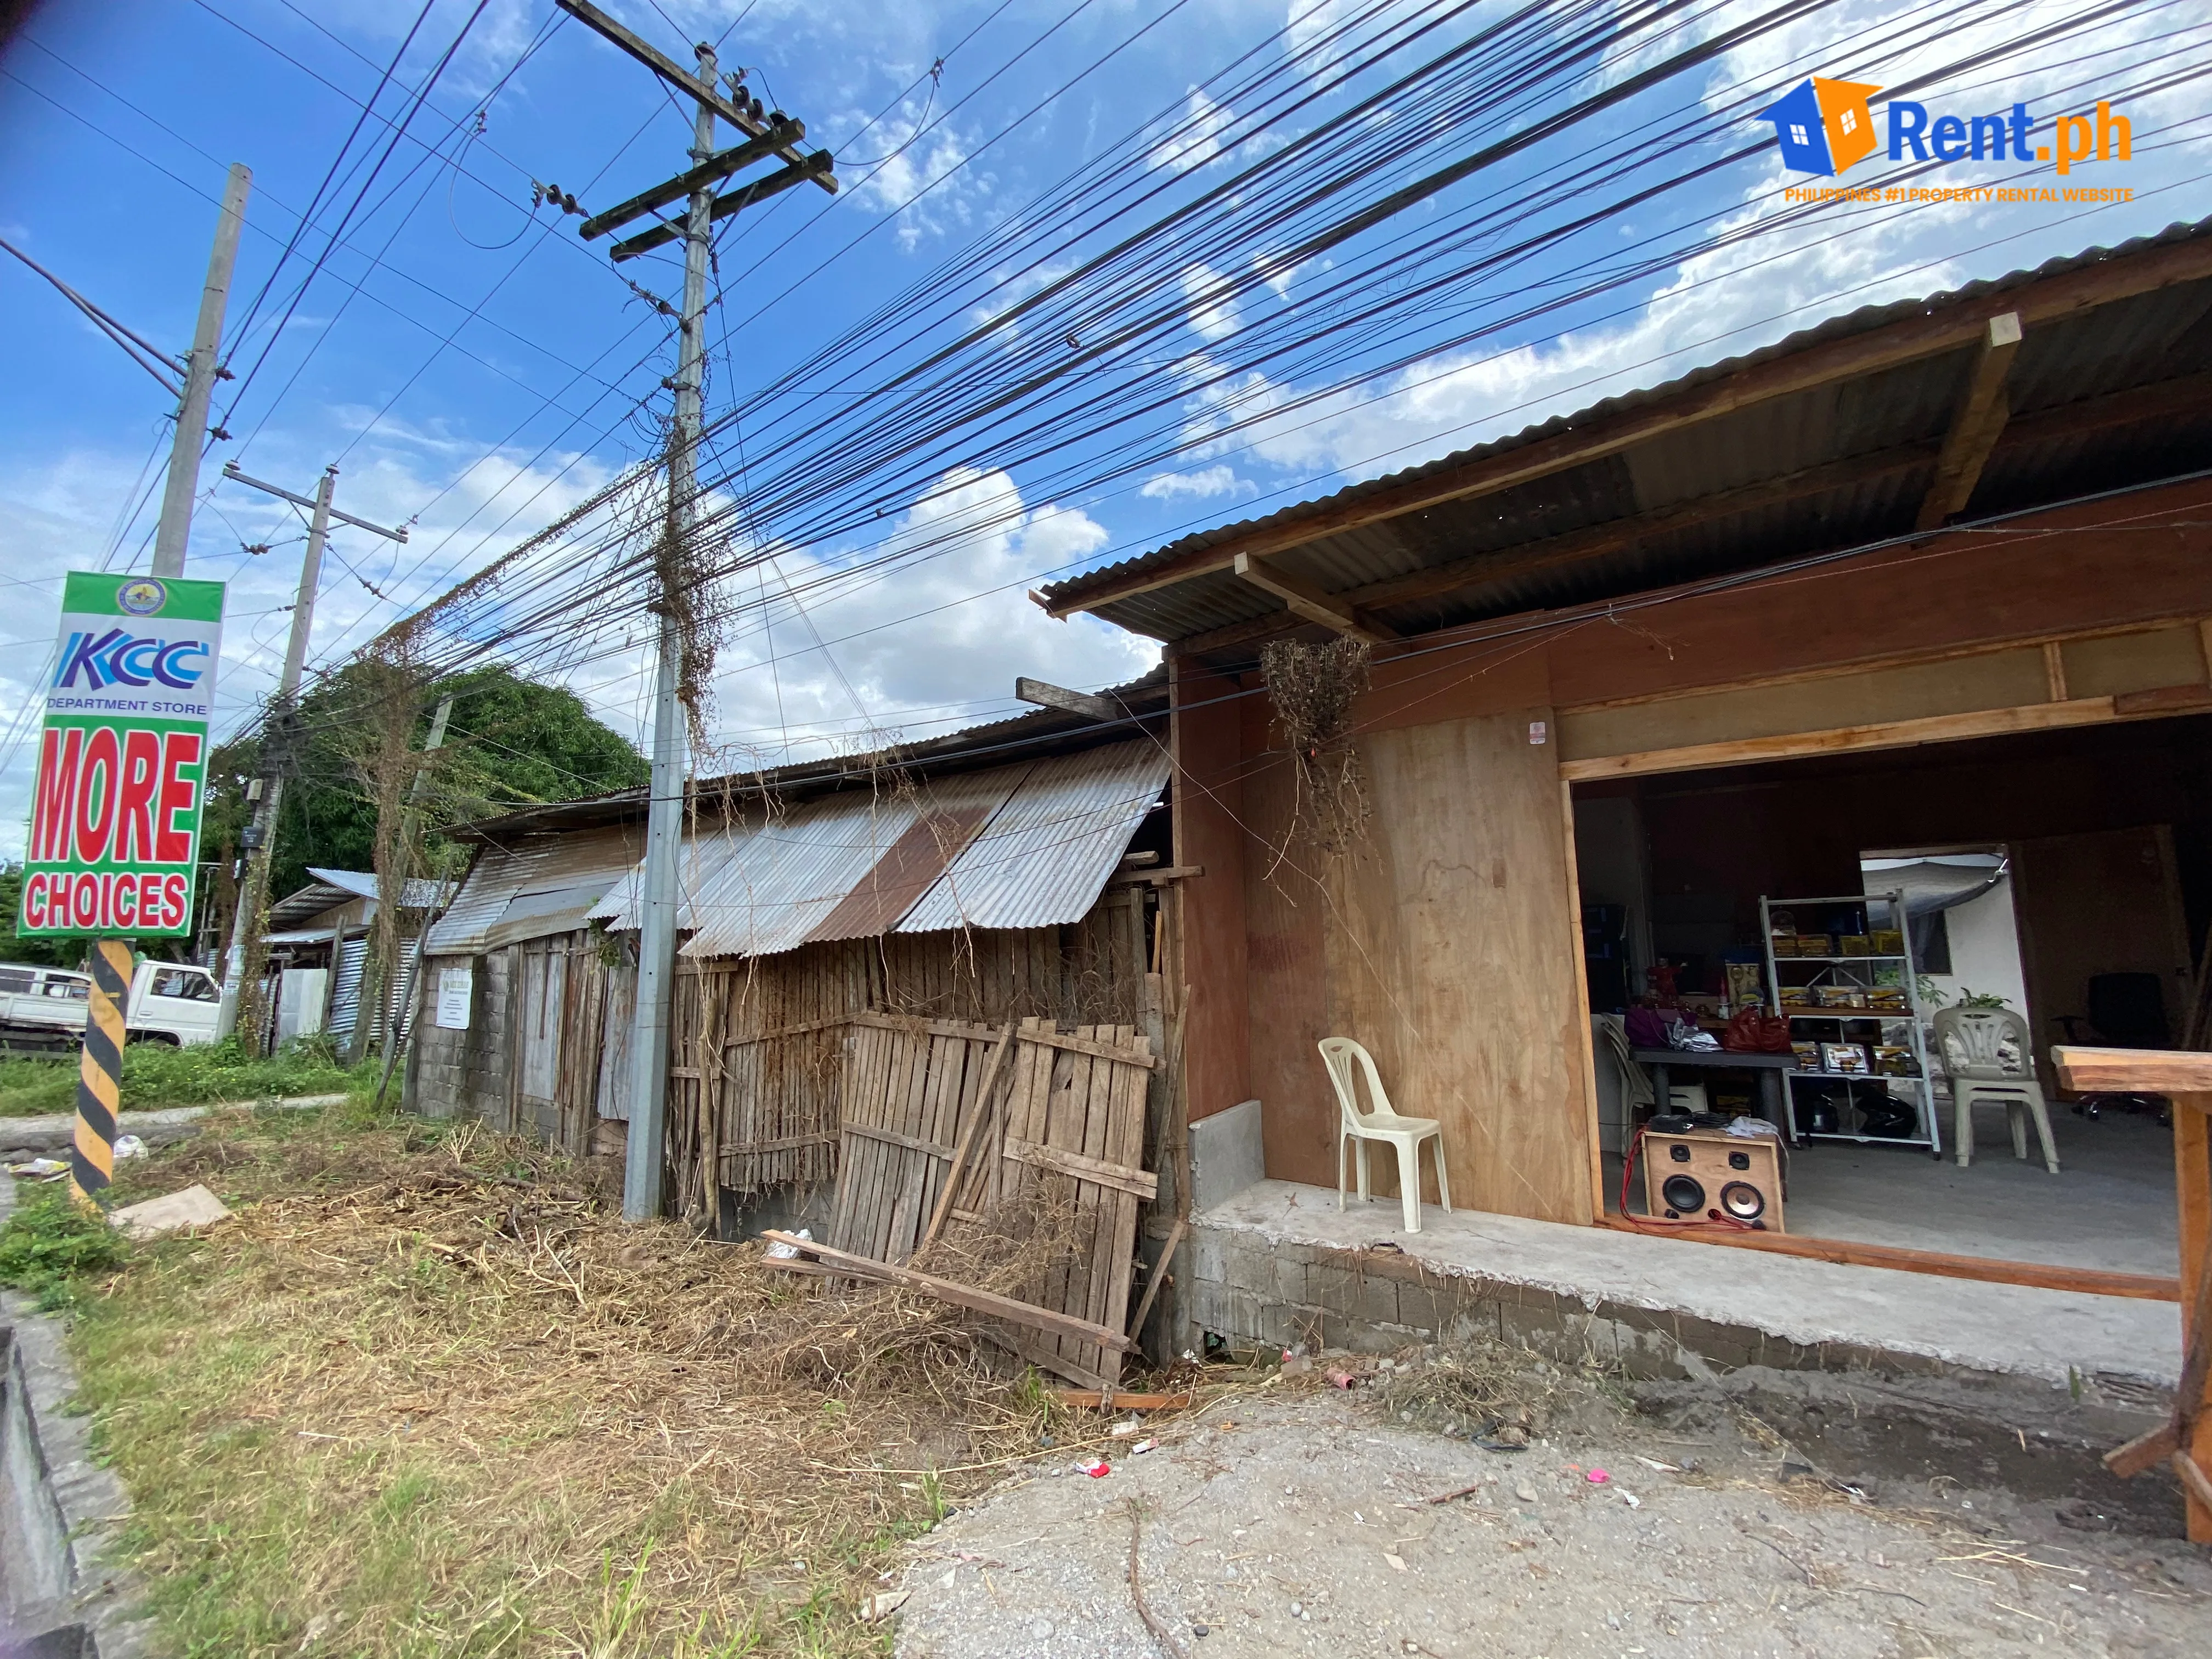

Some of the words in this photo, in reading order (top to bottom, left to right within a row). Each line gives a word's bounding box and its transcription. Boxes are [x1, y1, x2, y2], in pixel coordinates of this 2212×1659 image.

[53, 628, 210, 691] KCC
[47, 697, 149, 711] DEPARTMENT
[151, 701, 207, 715] STORE
[29, 726, 202, 865] MORE
[24, 873, 188, 929] CHOICES
